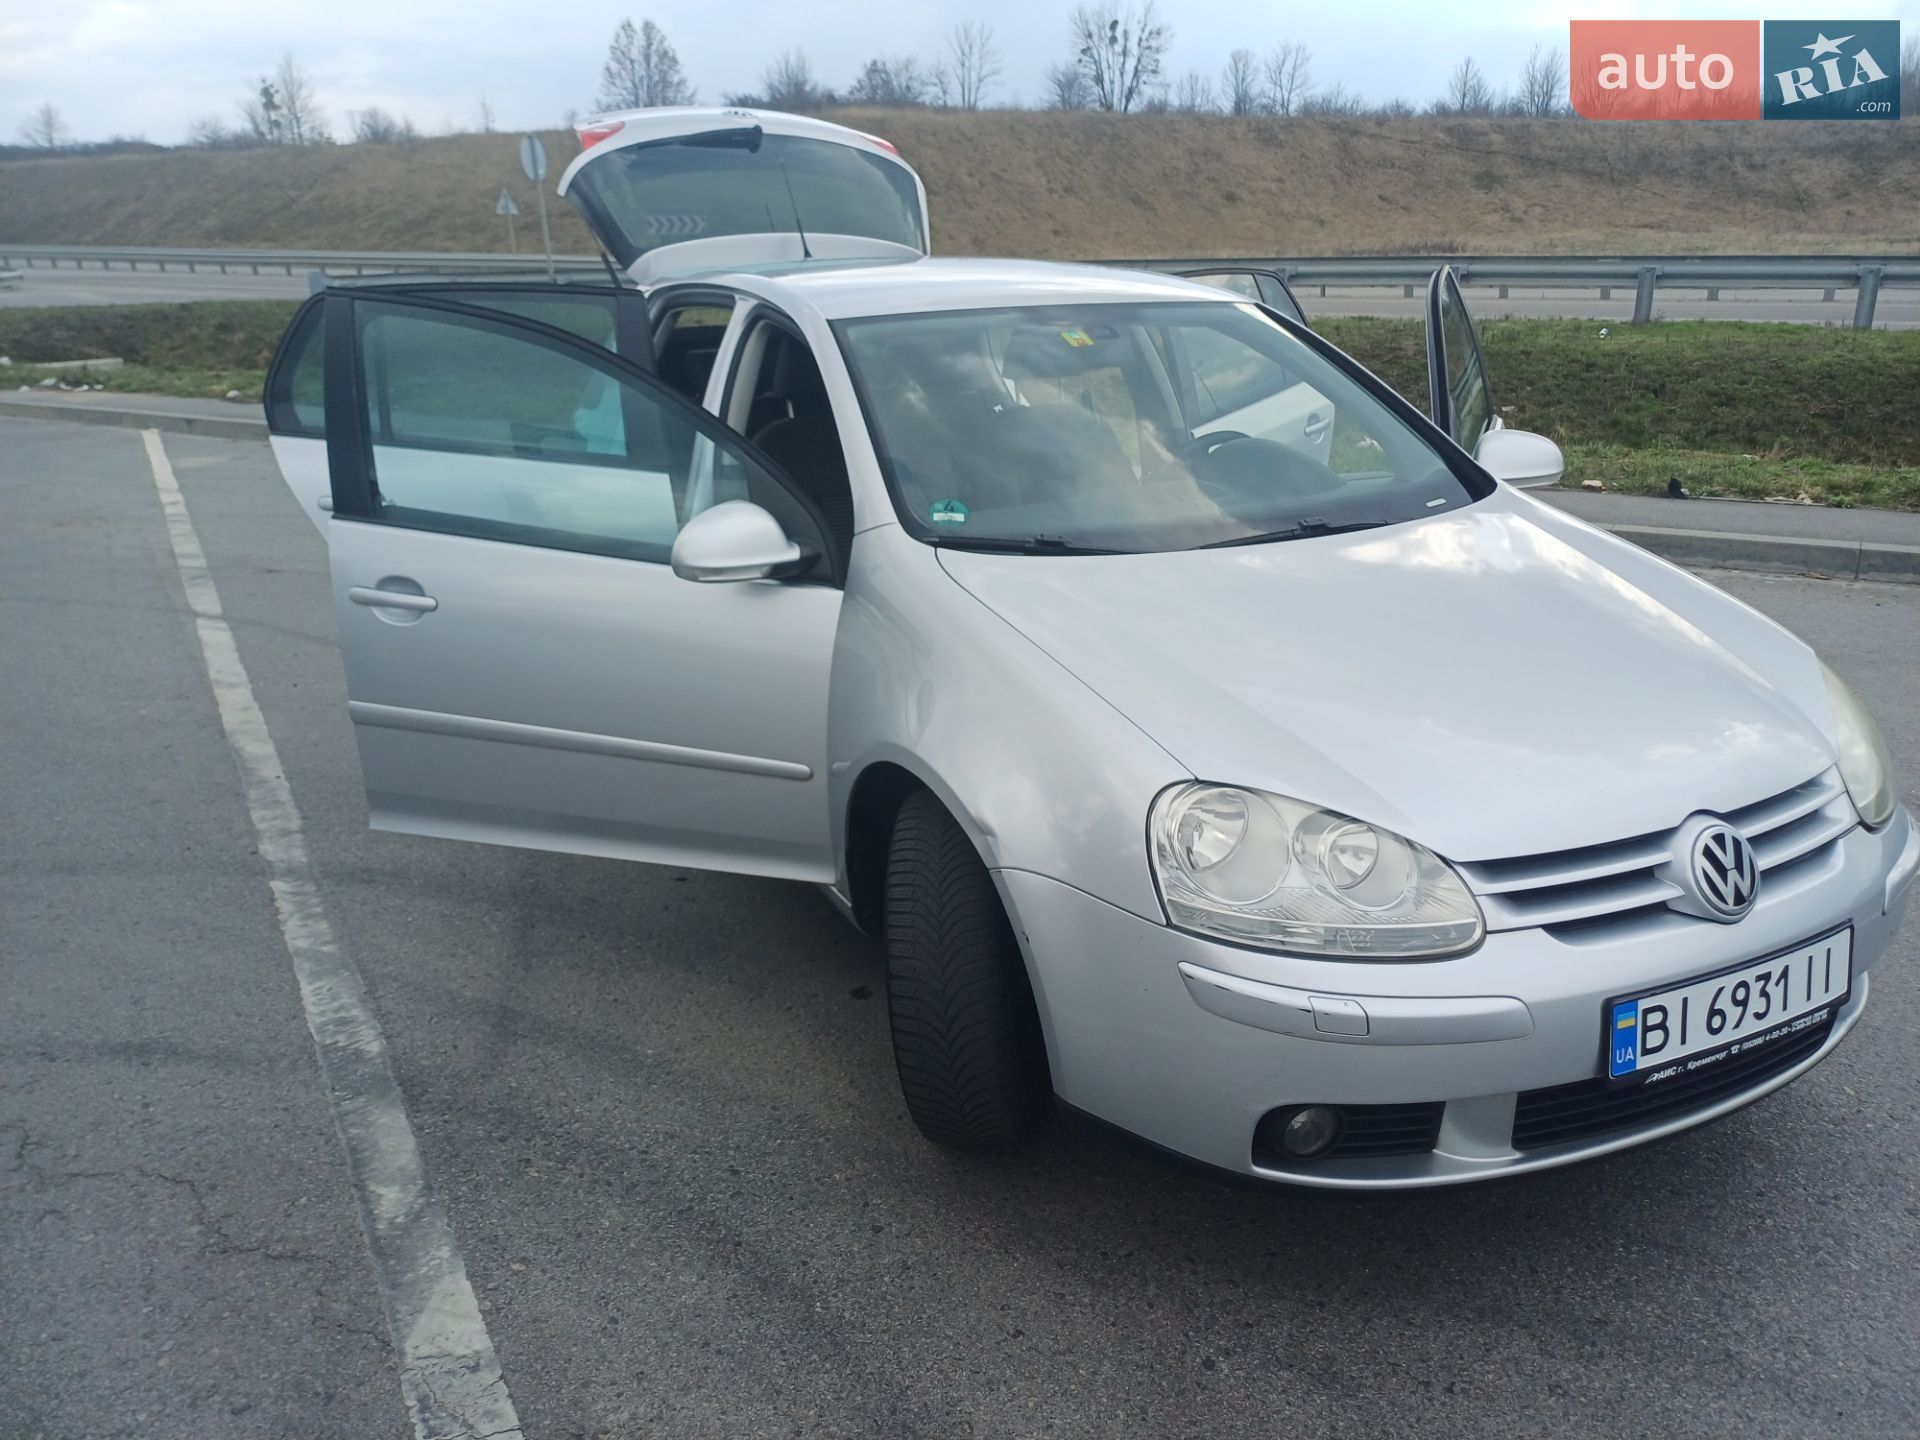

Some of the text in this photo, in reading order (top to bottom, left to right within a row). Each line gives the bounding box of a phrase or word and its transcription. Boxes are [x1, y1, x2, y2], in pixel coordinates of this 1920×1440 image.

[943, 499, 955, 512] 4
[1640, 947, 1832, 1057] BI 6931 II
[1616, 1049, 1635, 1064] UA
